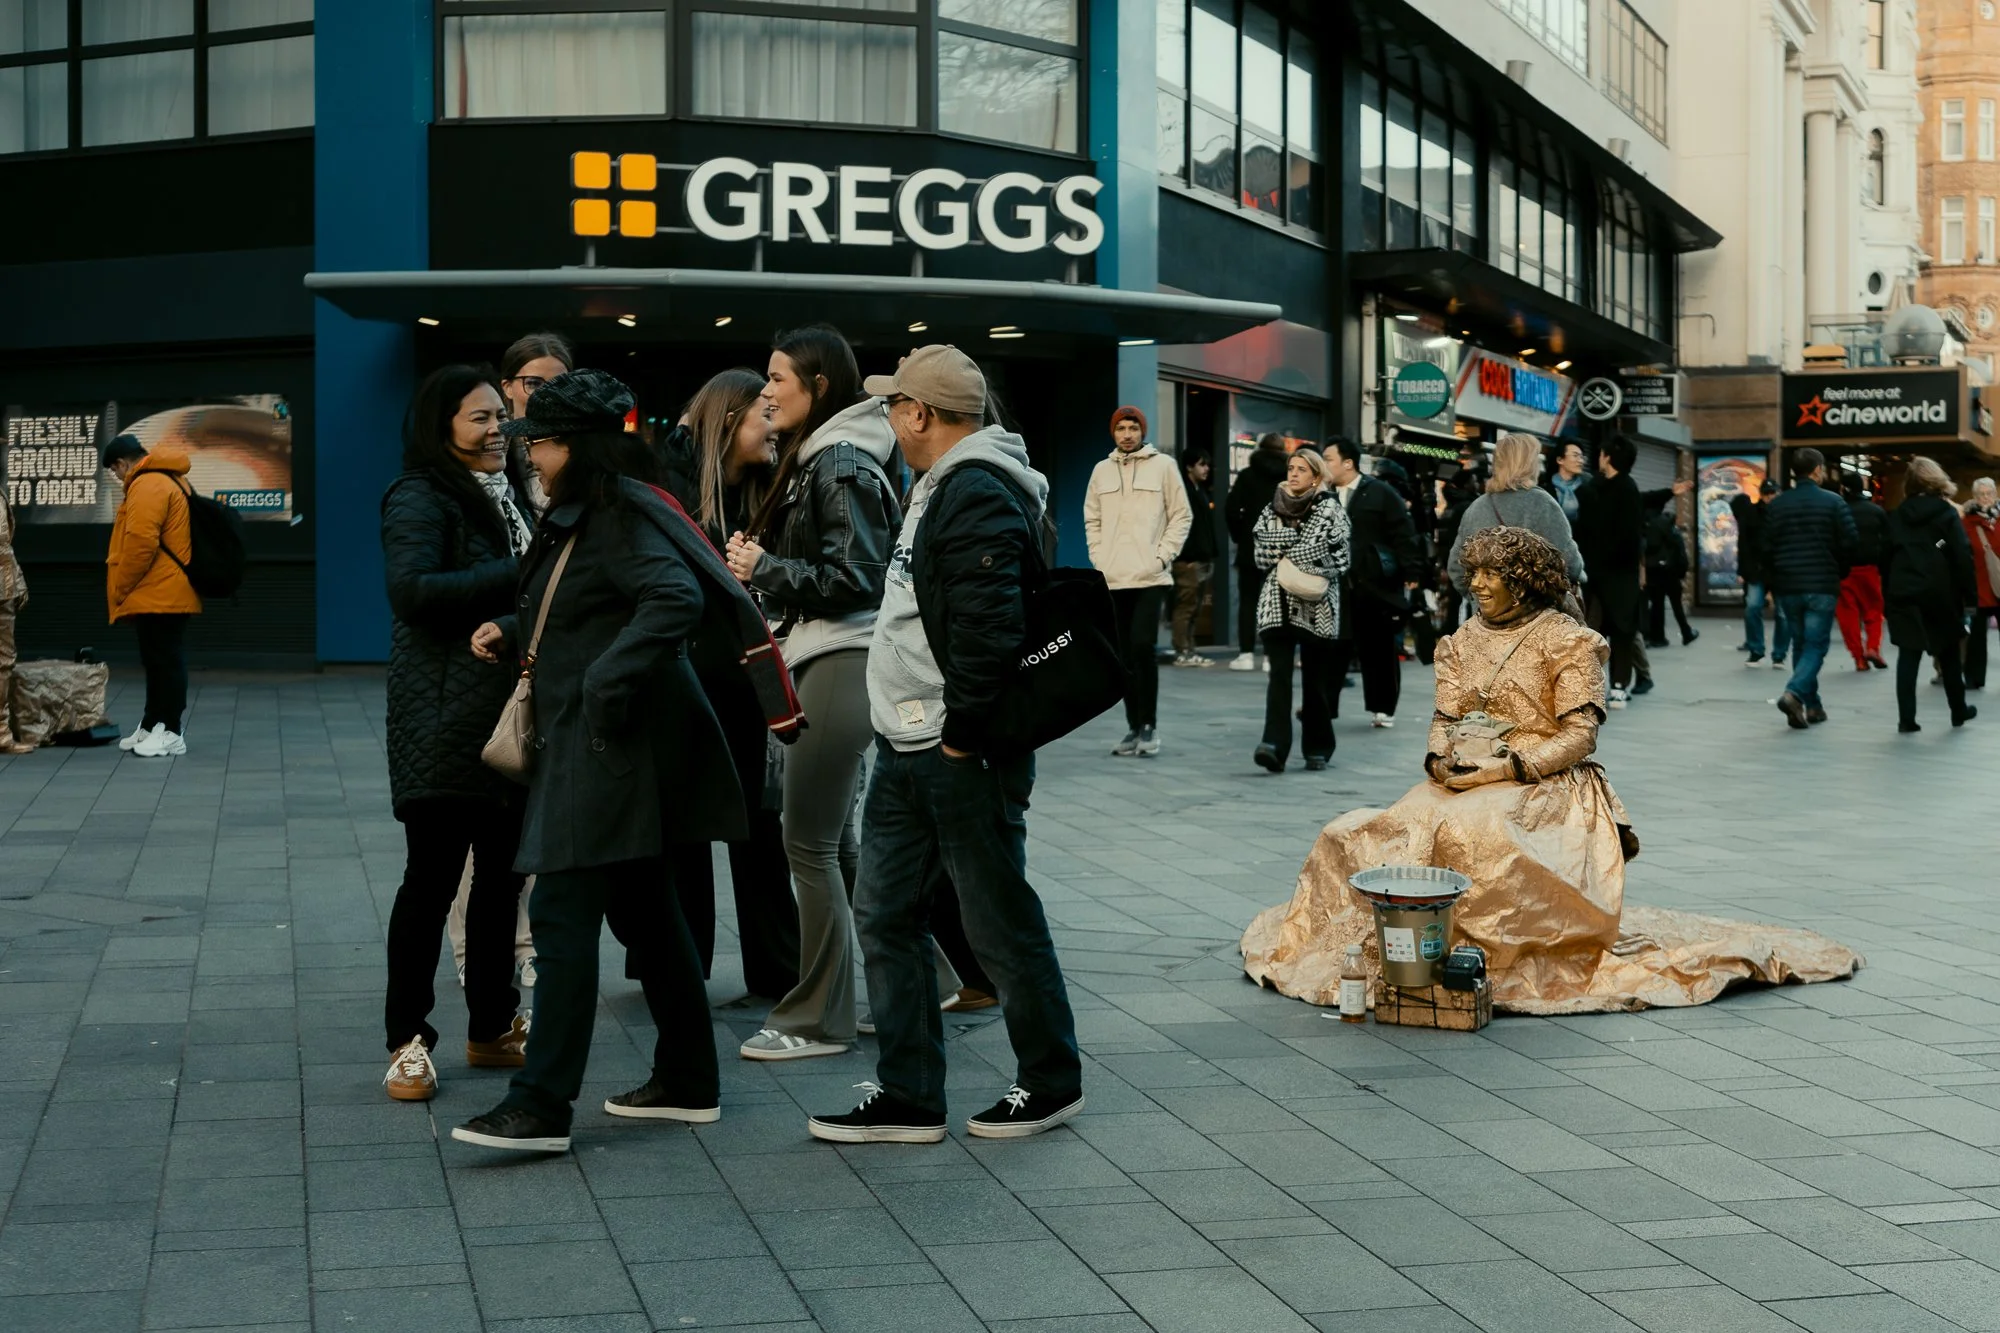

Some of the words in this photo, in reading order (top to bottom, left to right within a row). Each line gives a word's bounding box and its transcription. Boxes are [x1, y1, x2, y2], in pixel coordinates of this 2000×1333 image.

[685, 156, 1104, 255] GREGGS
[1396, 379, 1446, 393] TOBACCO
[1396, 394, 1419, 402] SOLD
[1420, 394, 1444, 402] HERE
[1823, 387, 1848, 399] feel
[1850, 389, 1884, 399] more
[1885, 387, 1901, 399] at
[1629, 405, 1659, 413] VAPES
[1825, 400, 1946, 425] cineworld
[9, 415, 98, 446] FRESHLY
[7, 446, 98, 478] GROUND
[7, 480, 31, 506] TO
[35, 479, 97, 505] ORDER
[229, 493, 282, 507] GREGGS
[1017, 629, 1073, 671] MOUSSY
